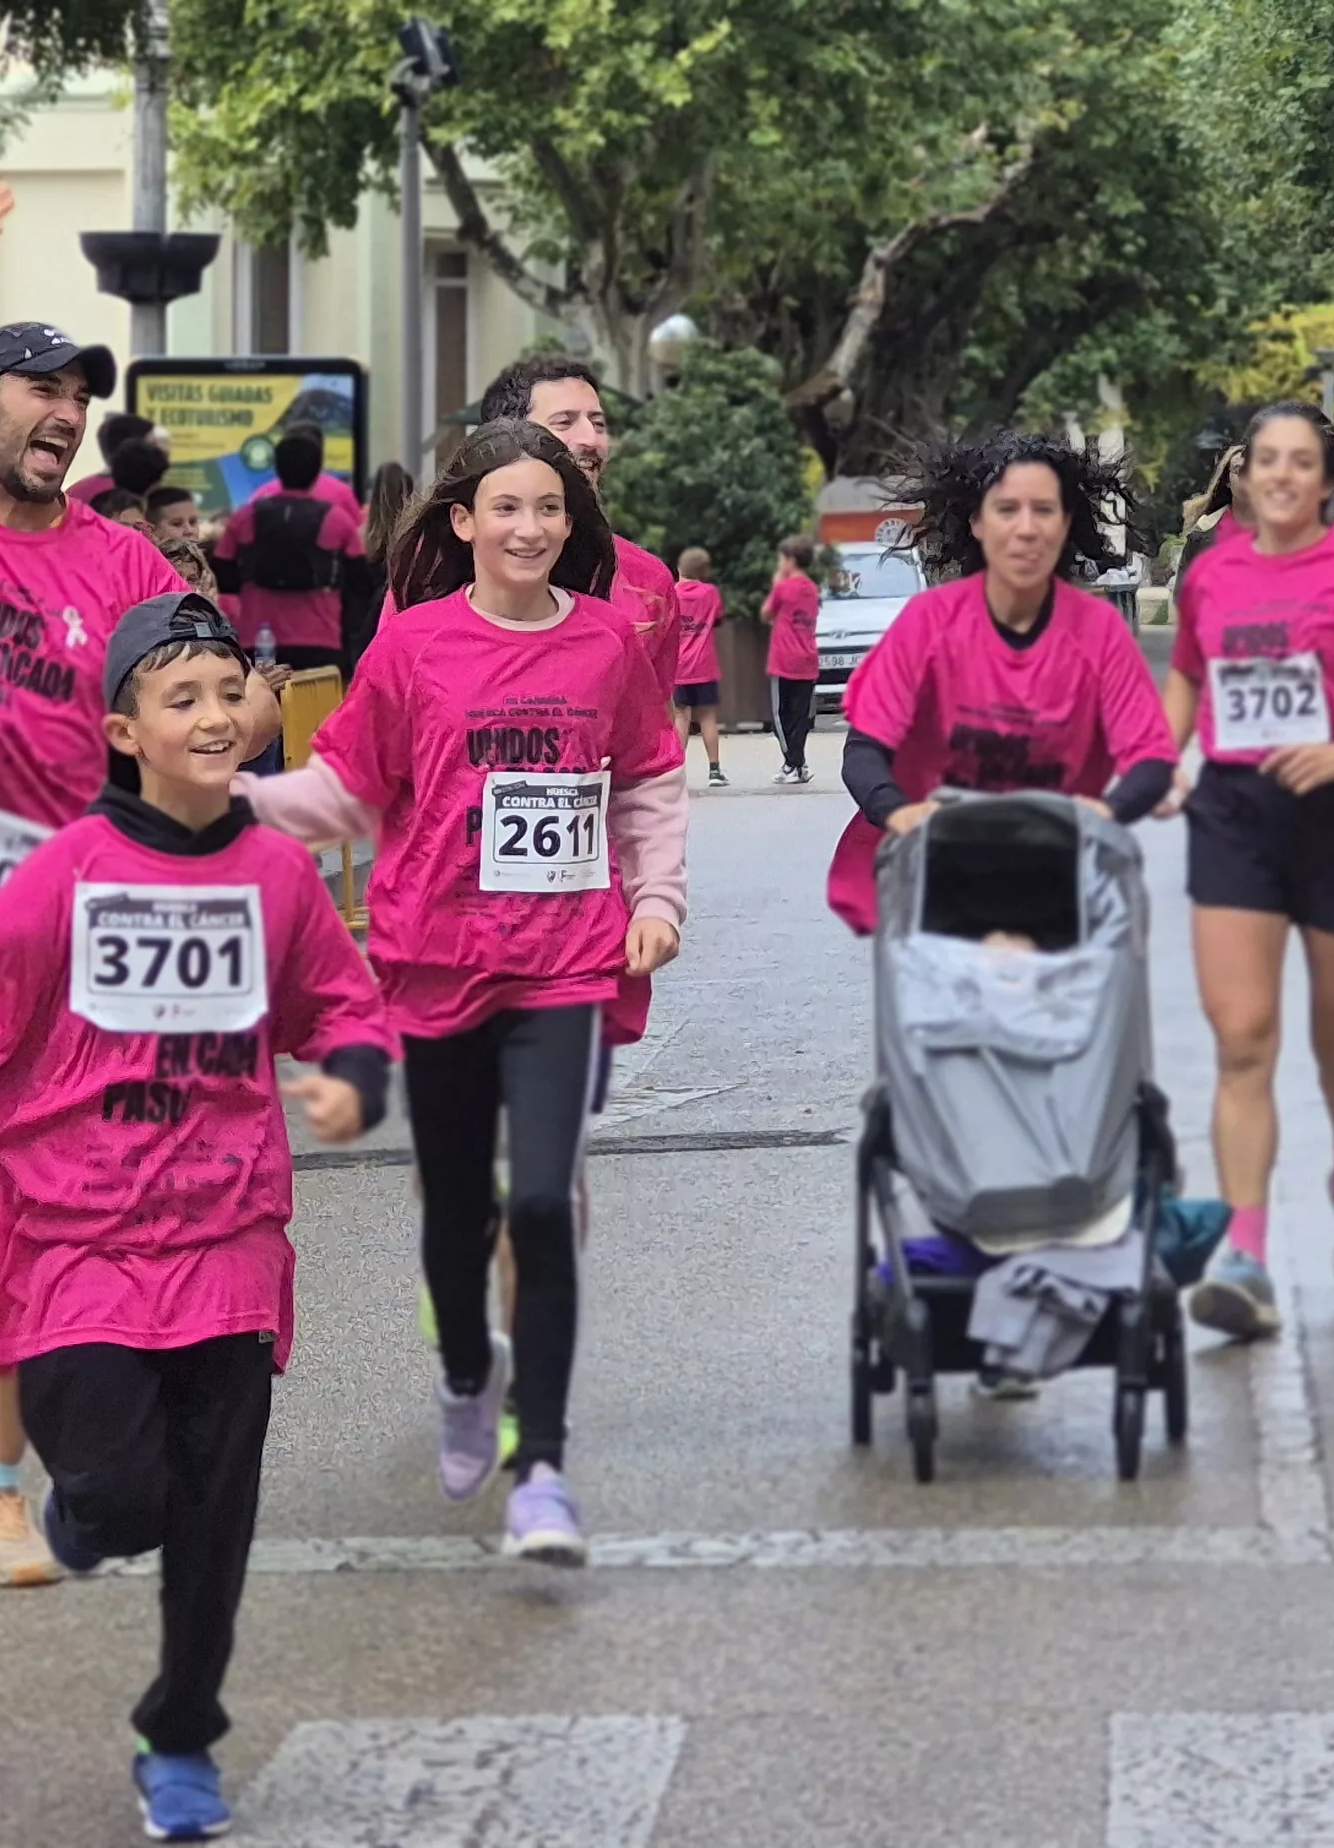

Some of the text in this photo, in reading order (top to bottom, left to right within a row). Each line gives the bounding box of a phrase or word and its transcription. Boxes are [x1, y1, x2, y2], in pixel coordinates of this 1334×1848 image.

[146, 384, 273, 405] VISITAS GUIADAS
[160, 408, 254, 427] ECOTURISMO
[1228, 682, 1317, 721] 3702
[466, 726, 560, 768] UNIDOS
[502, 796, 555, 808] CONTRA
[557, 797, 571, 809] EL
[498, 812, 595, 857] 2611
[97, 913, 164, 928] CONTRA
[169, 913, 185, 928] EL
[94, 934, 243, 989] 3701
